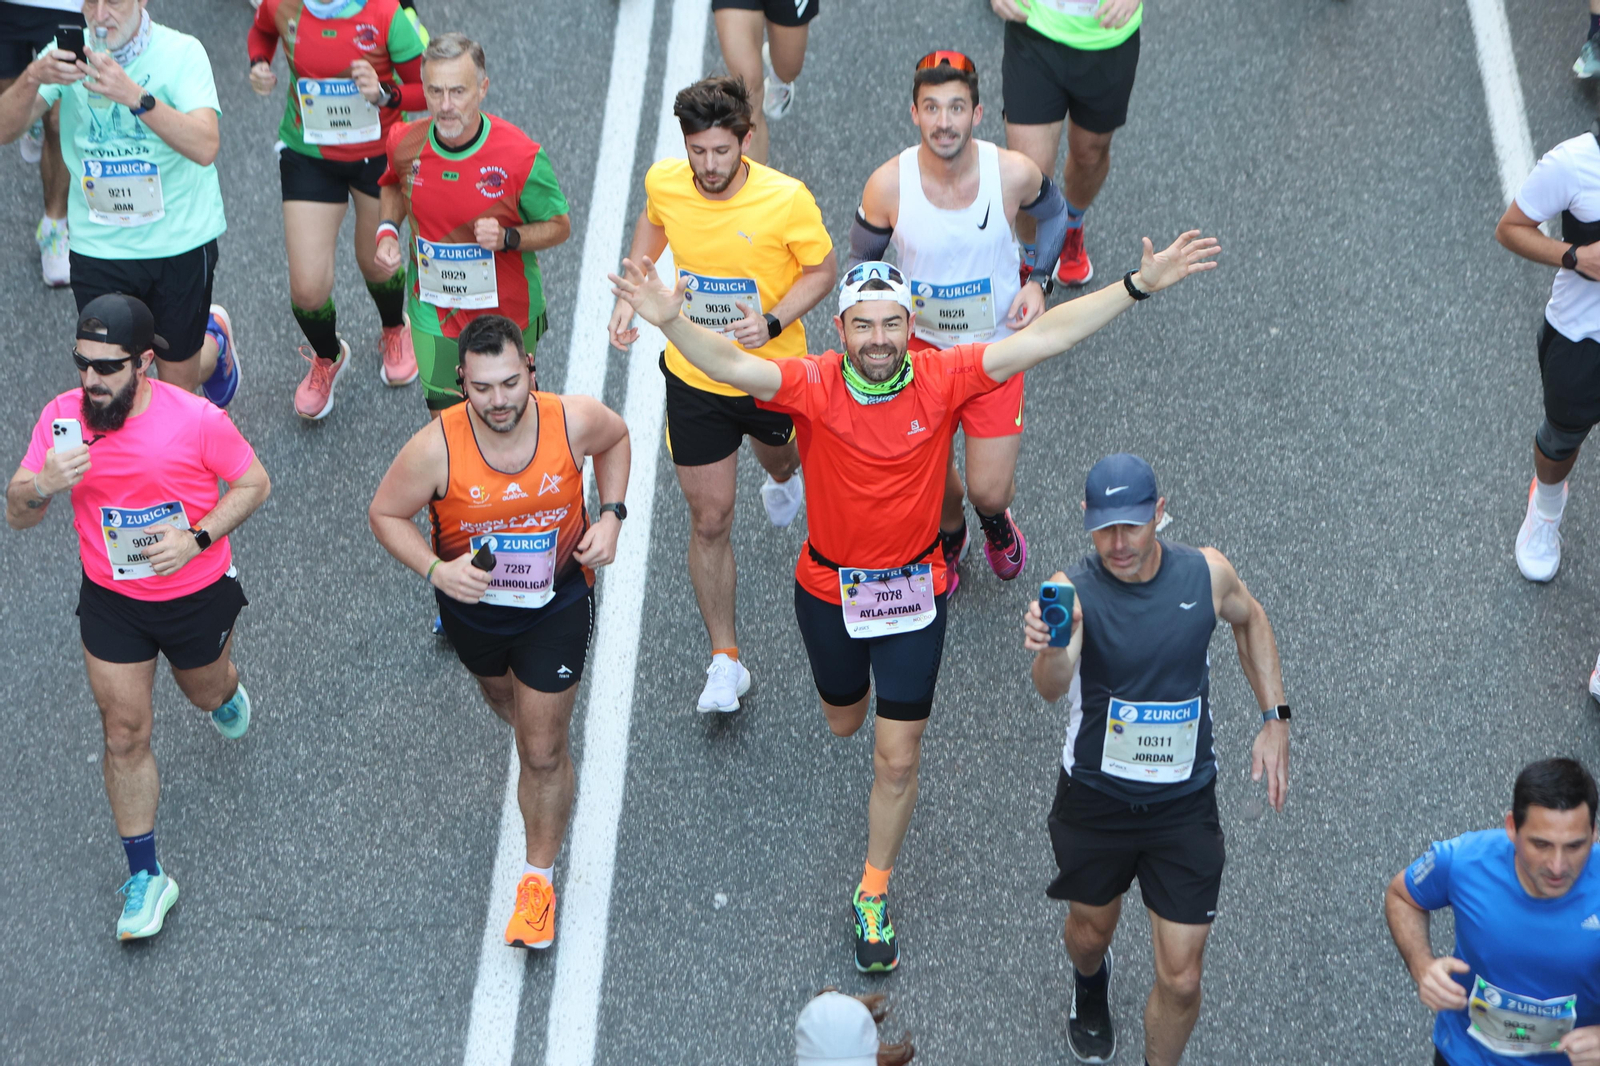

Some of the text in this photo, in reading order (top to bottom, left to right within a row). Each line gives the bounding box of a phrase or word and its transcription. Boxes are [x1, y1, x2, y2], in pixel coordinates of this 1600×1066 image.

[324, 83, 359, 94] ZURIC
[329, 120, 352, 128] INMA
[105, 162, 151, 175] ZURICH
[108, 187, 132, 198] 9211
[112, 203, 134, 211] JOAN
[439, 248, 482, 259] ZURICH
[441, 270, 466, 280] 8929
[442, 284, 468, 293] RICKY
[703, 281, 746, 292] ZURICH
[938, 283, 981, 298] ZURICH
[705, 303, 731, 313] 9036
[689, 315, 728, 326] BARCELÓ
[938, 322, 969, 331] DRAGO
[125, 507, 171, 525] ZURICH
[132, 534, 159, 548] 9021
[503, 538, 550, 550] ZURICH
[504, 564, 531, 574] 7287
[875, 589, 902, 602] 7078
[860, 603, 921, 618] AYLA-AITANA
[1143, 707, 1190, 720] ZURICH
[1137, 736, 1172, 747] 10311
[1132, 753, 1174, 763] JORDAN
[1507, 999, 1561, 1017] ZURICH
